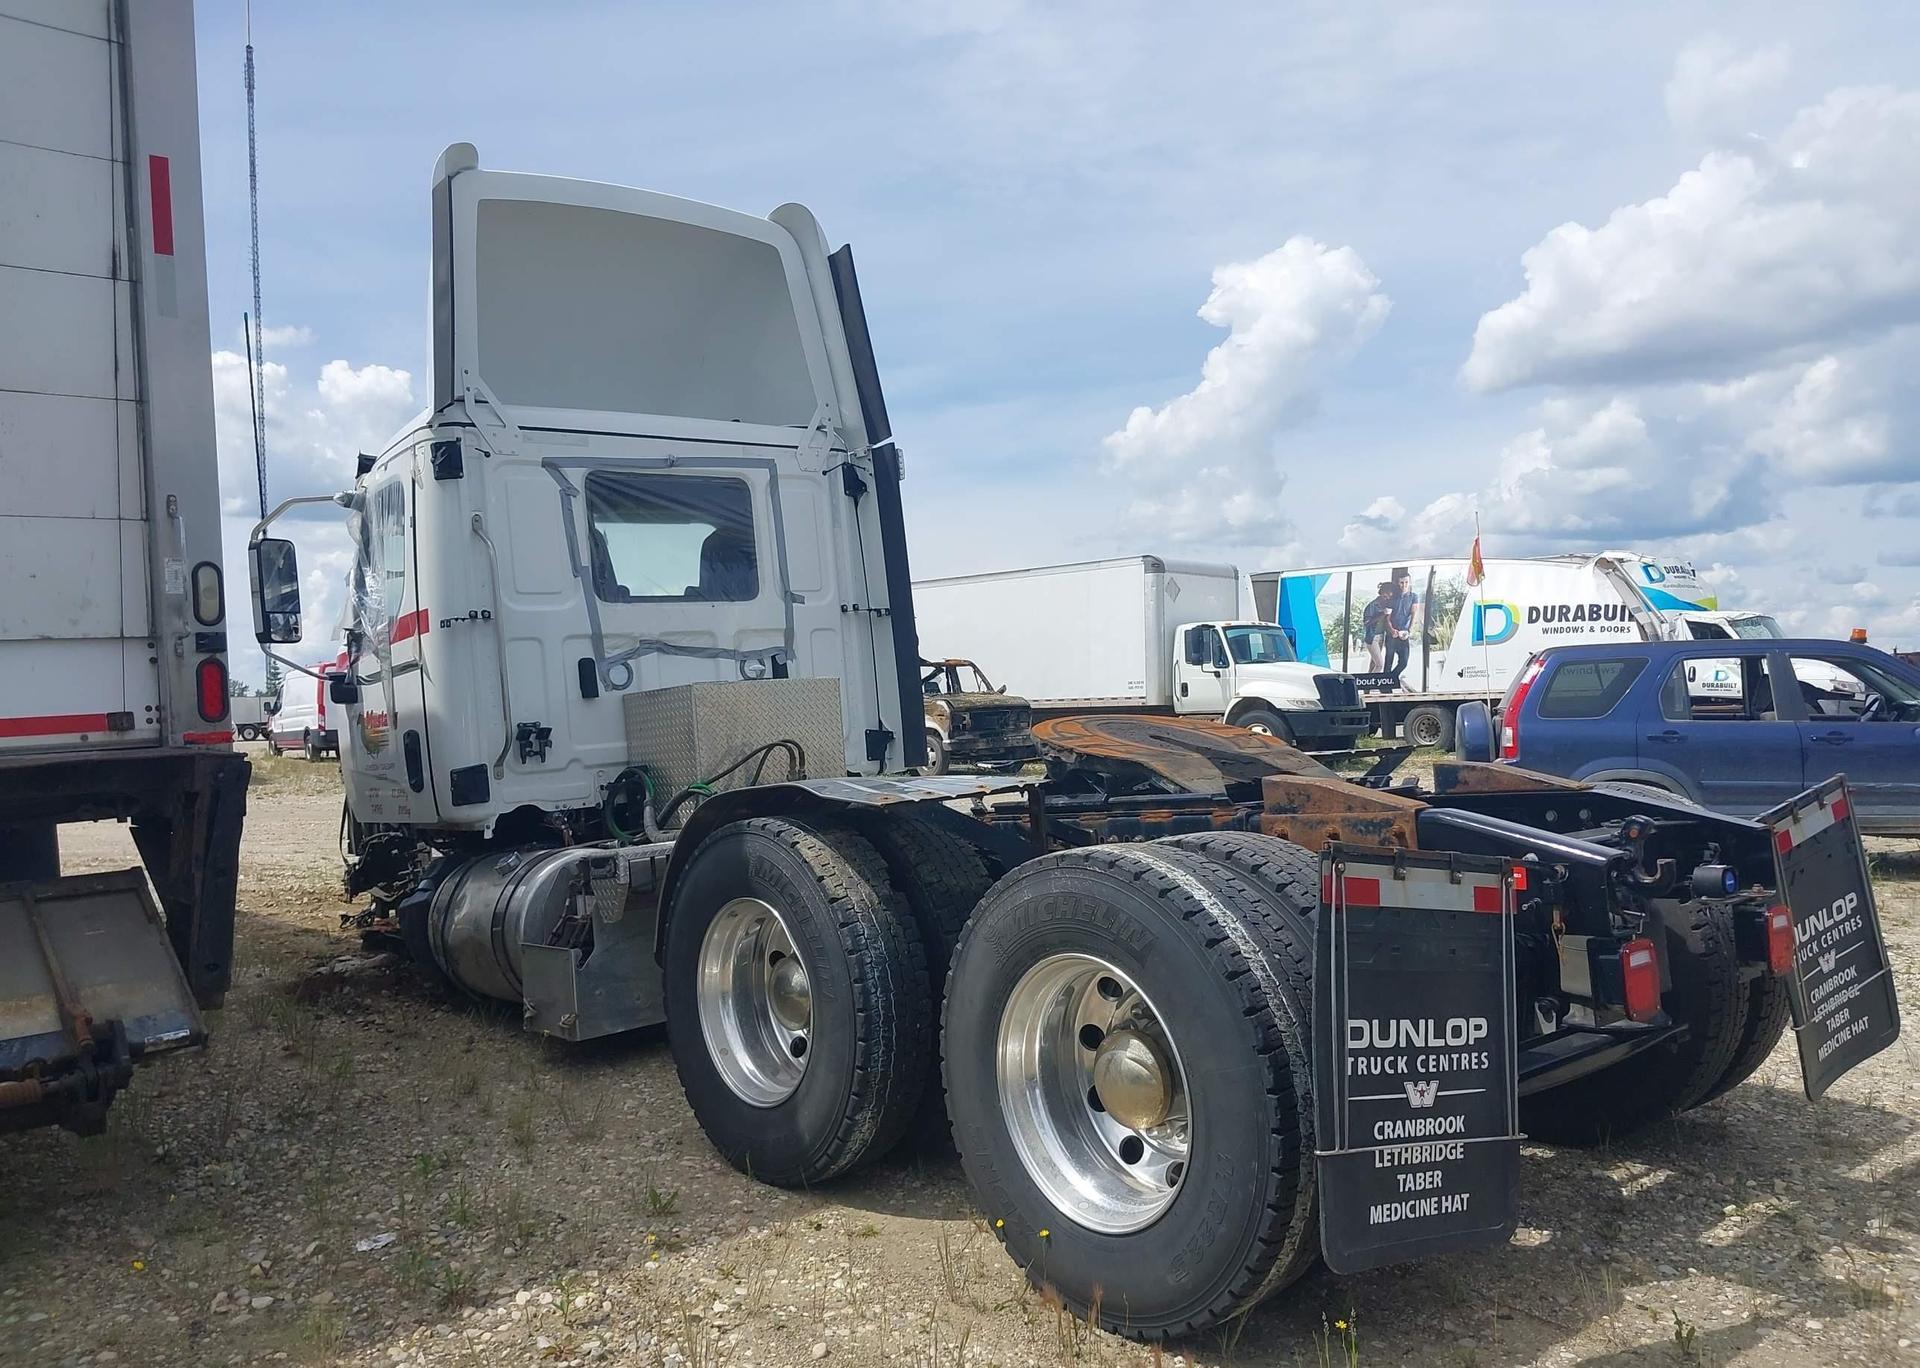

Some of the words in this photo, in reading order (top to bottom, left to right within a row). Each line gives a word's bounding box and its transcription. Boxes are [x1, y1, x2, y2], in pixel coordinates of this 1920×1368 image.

[1542, 626, 1585, 635] WINDOWS
[1600, 626, 1631, 634] DOORS
[1356, 677, 1376, 686] bout
[1377, 678, 1395, 687] you.
[1003, 895, 1154, 951] MICHELIN
[1799, 940, 1819, 965] UCK
[1821, 914, 1863, 948] CENTRES
[1810, 965, 1858, 1004] CRANBROOK
[1347, 1017, 1488, 1049] DUNLOP
[1825, 1008, 1851, 1033] TABER
[1818, 1026, 1852, 1062] MEDICINE
[1851, 1016, 1869, 1036] HAT
[1347, 1056, 1409, 1076] TRUCK
[1416, 1052, 1490, 1073] CENTRES
[1373, 1115, 1466, 1140] CRANBROOK
[1374, 1142, 1465, 1168] LETHBRIDGE
[1397, 1170, 1443, 1193] TABER
[1369, 1196, 1439, 1225] MEDICINE
[1441, 1193, 1471, 1214] HAT
